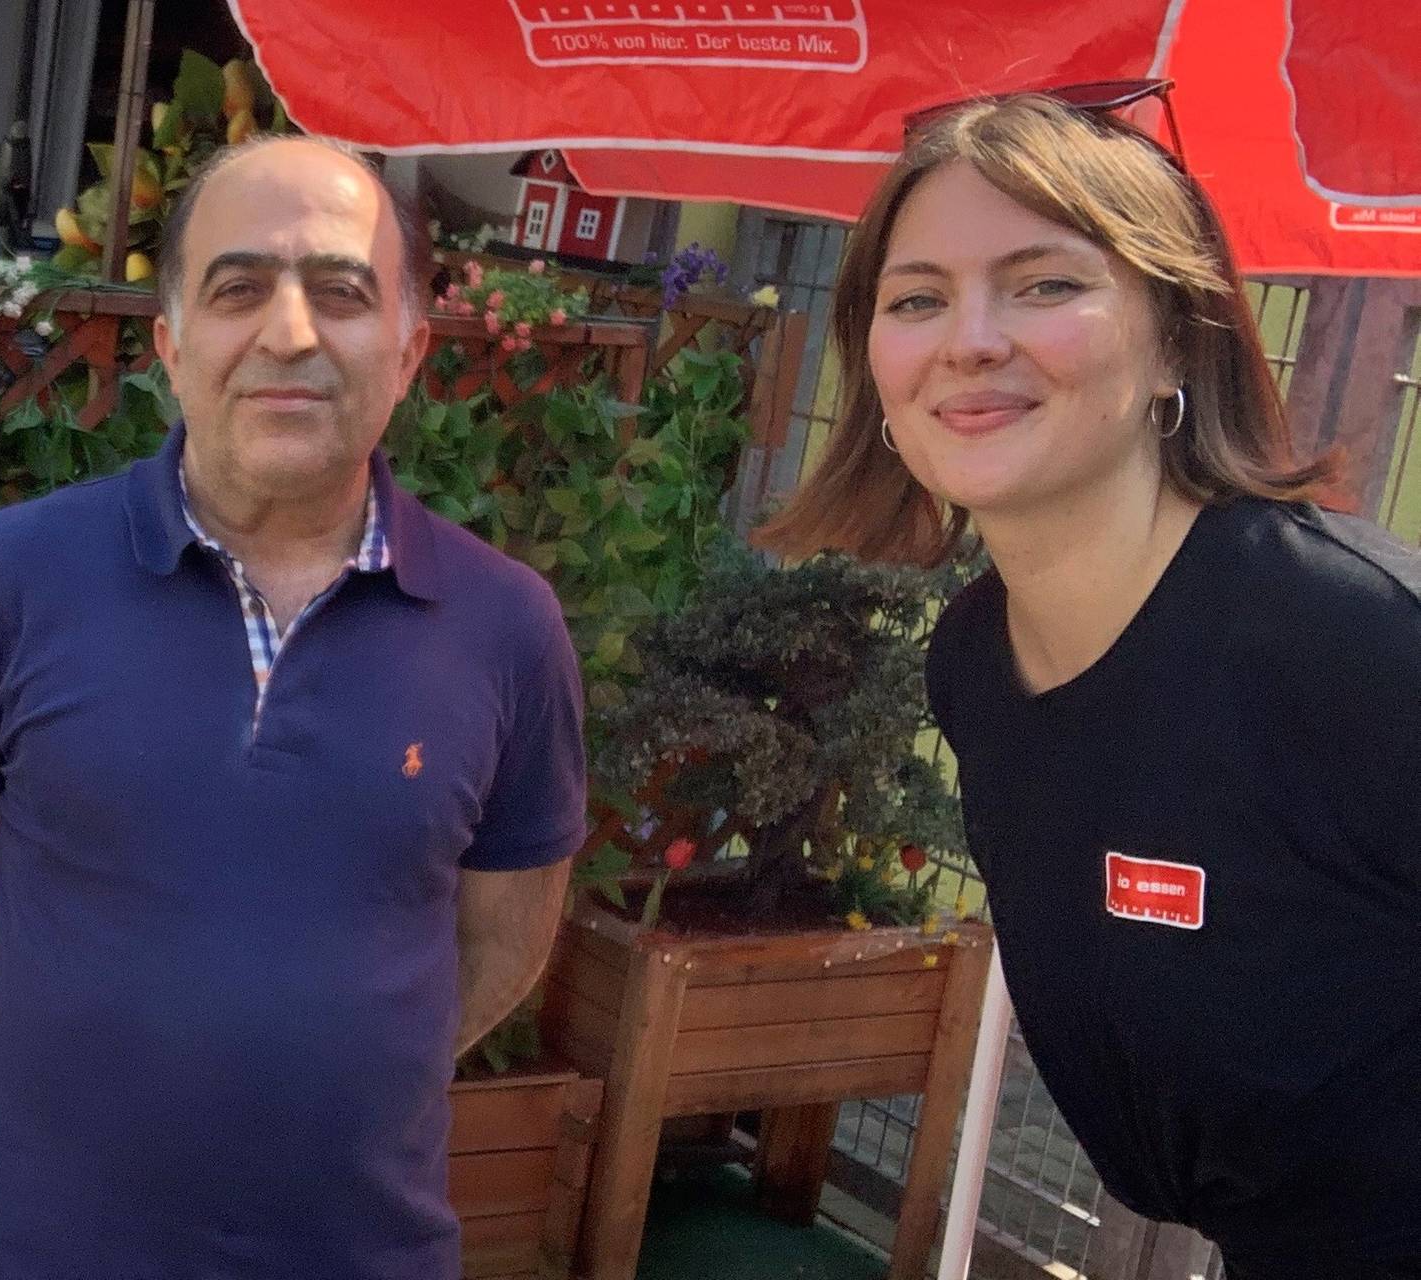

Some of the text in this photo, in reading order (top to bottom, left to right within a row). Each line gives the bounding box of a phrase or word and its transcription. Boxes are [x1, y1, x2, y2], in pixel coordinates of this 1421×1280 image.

[550, 32, 838, 54] 100% von hier. Der beste Mix.
